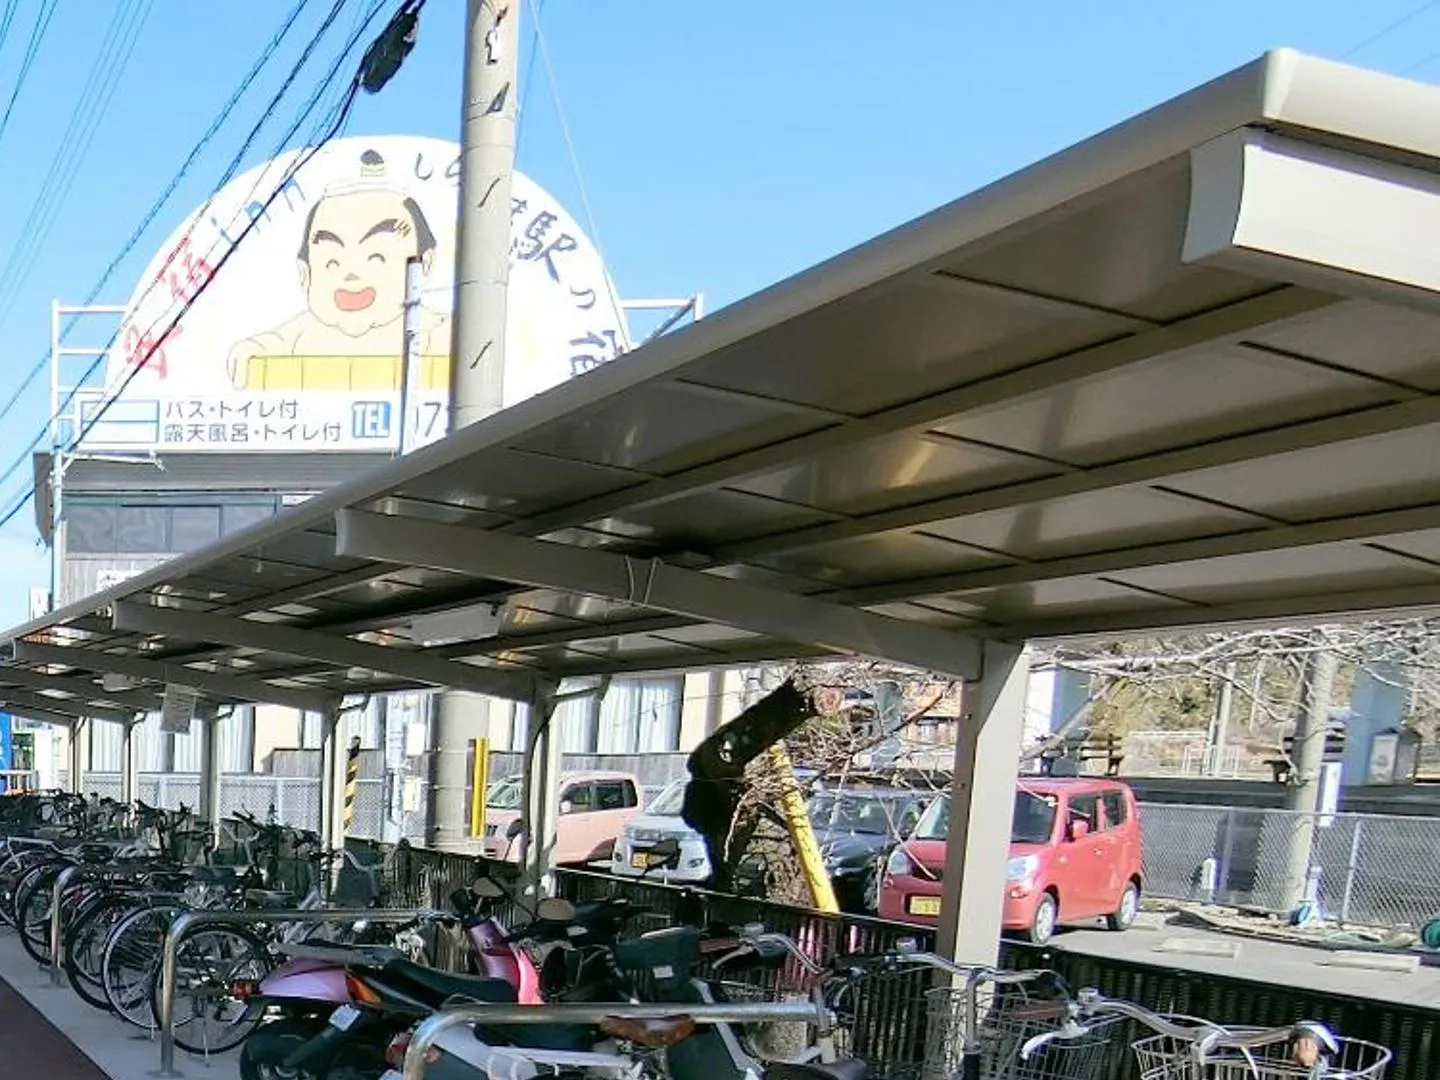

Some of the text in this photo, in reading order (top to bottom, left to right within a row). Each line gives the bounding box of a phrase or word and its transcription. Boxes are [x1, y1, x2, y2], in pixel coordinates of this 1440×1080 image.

[164, 423, 342, 442] 露天風呂・トイレ付
[352, 401, 390, 438] TEL
